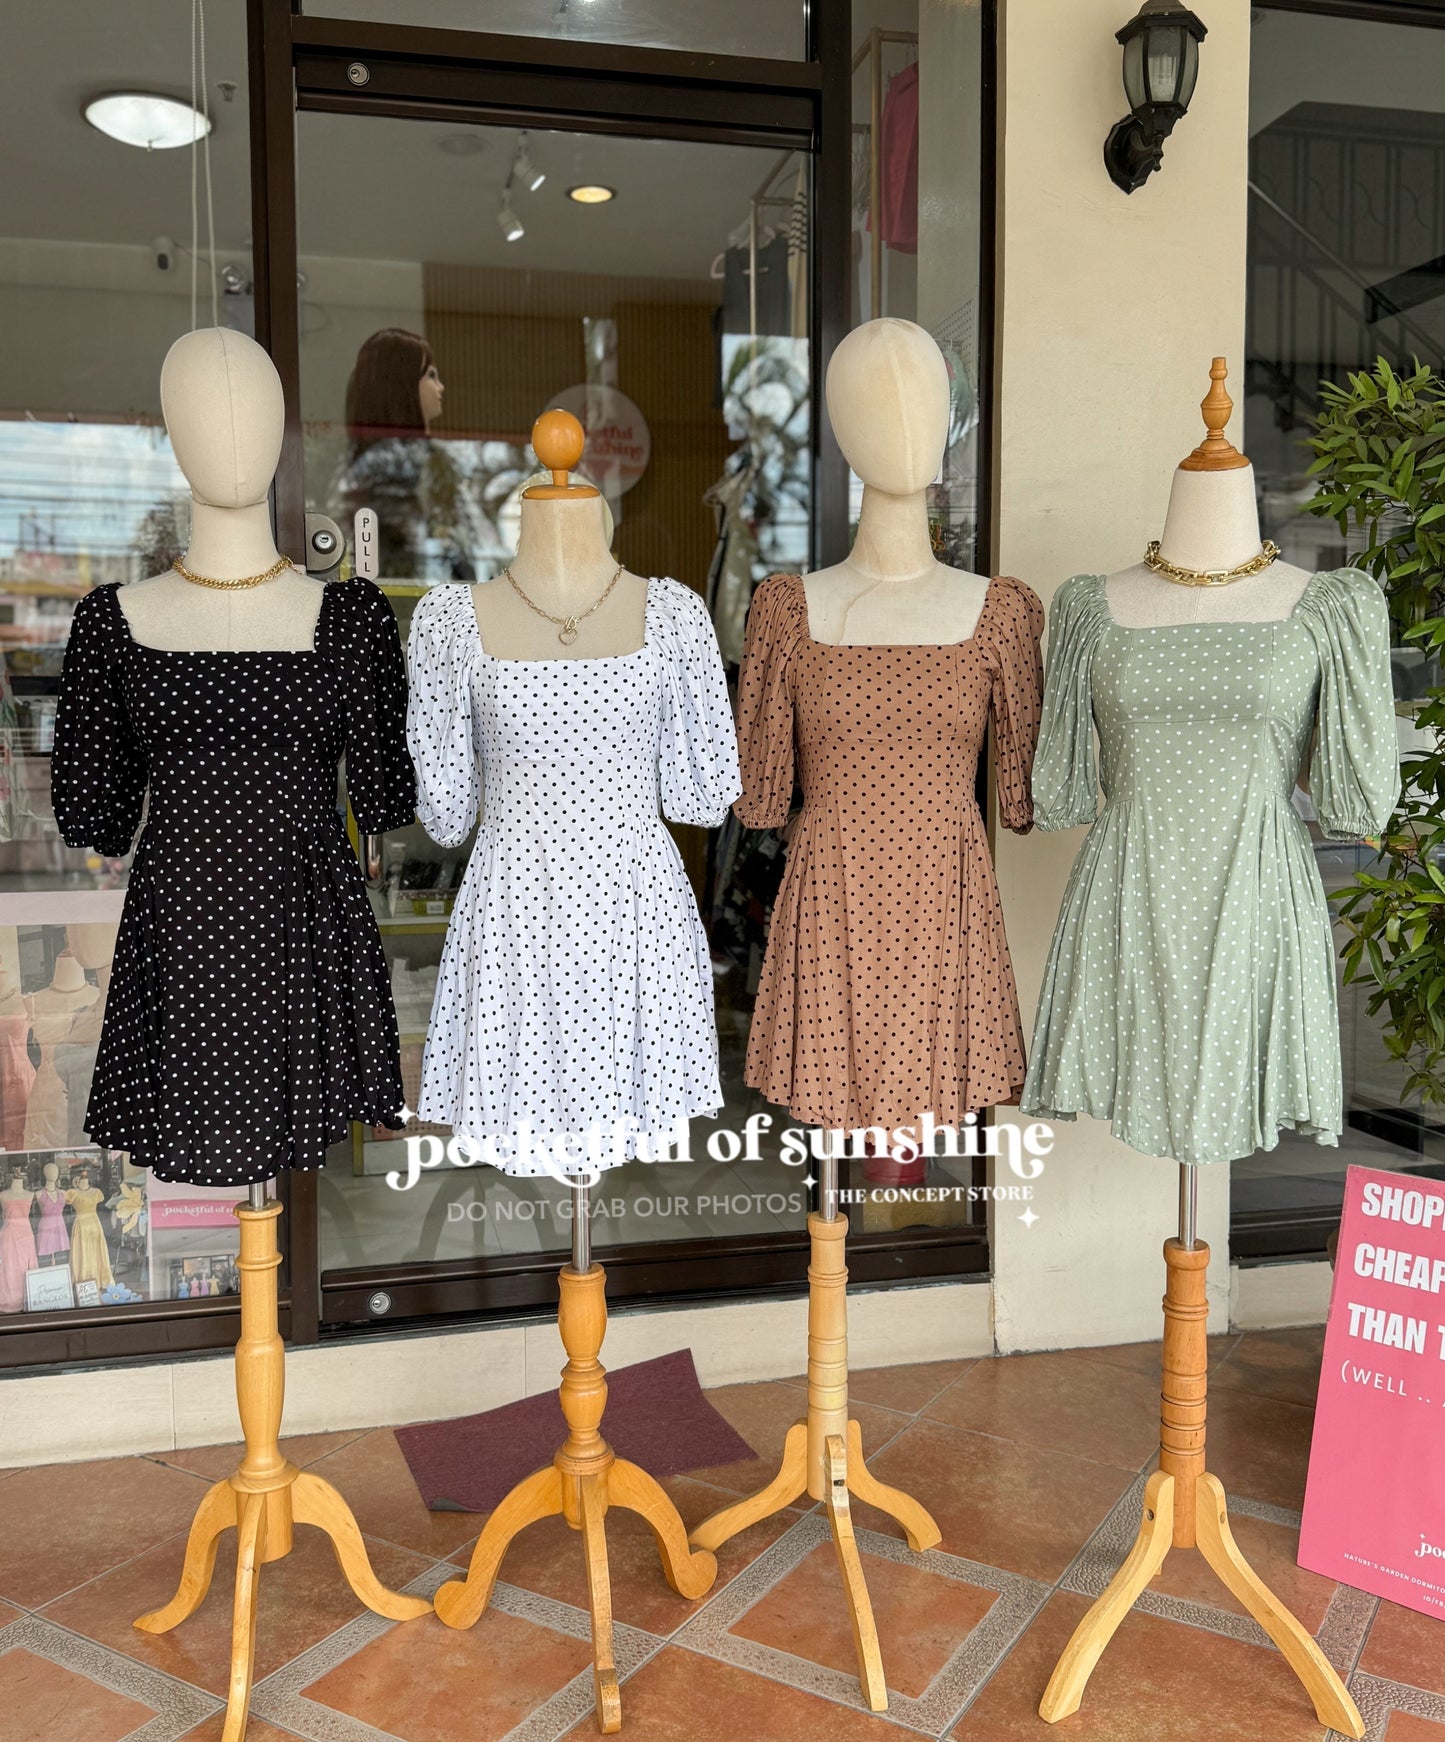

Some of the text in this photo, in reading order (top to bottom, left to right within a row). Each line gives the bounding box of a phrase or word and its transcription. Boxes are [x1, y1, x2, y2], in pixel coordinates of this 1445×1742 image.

[361, 517, 371, 573] PULL
[161, 1205, 214, 1217] pocketful
[1361, 1182, 1445, 1232] SHOP
[1348, 1302, 1427, 1355] THAN
[1343, 1552, 1379, 1569] NATURE'S
[1380, 1566, 1409, 1581] GARDEN
[1423, 1594, 1445, 1610] IG/FB
